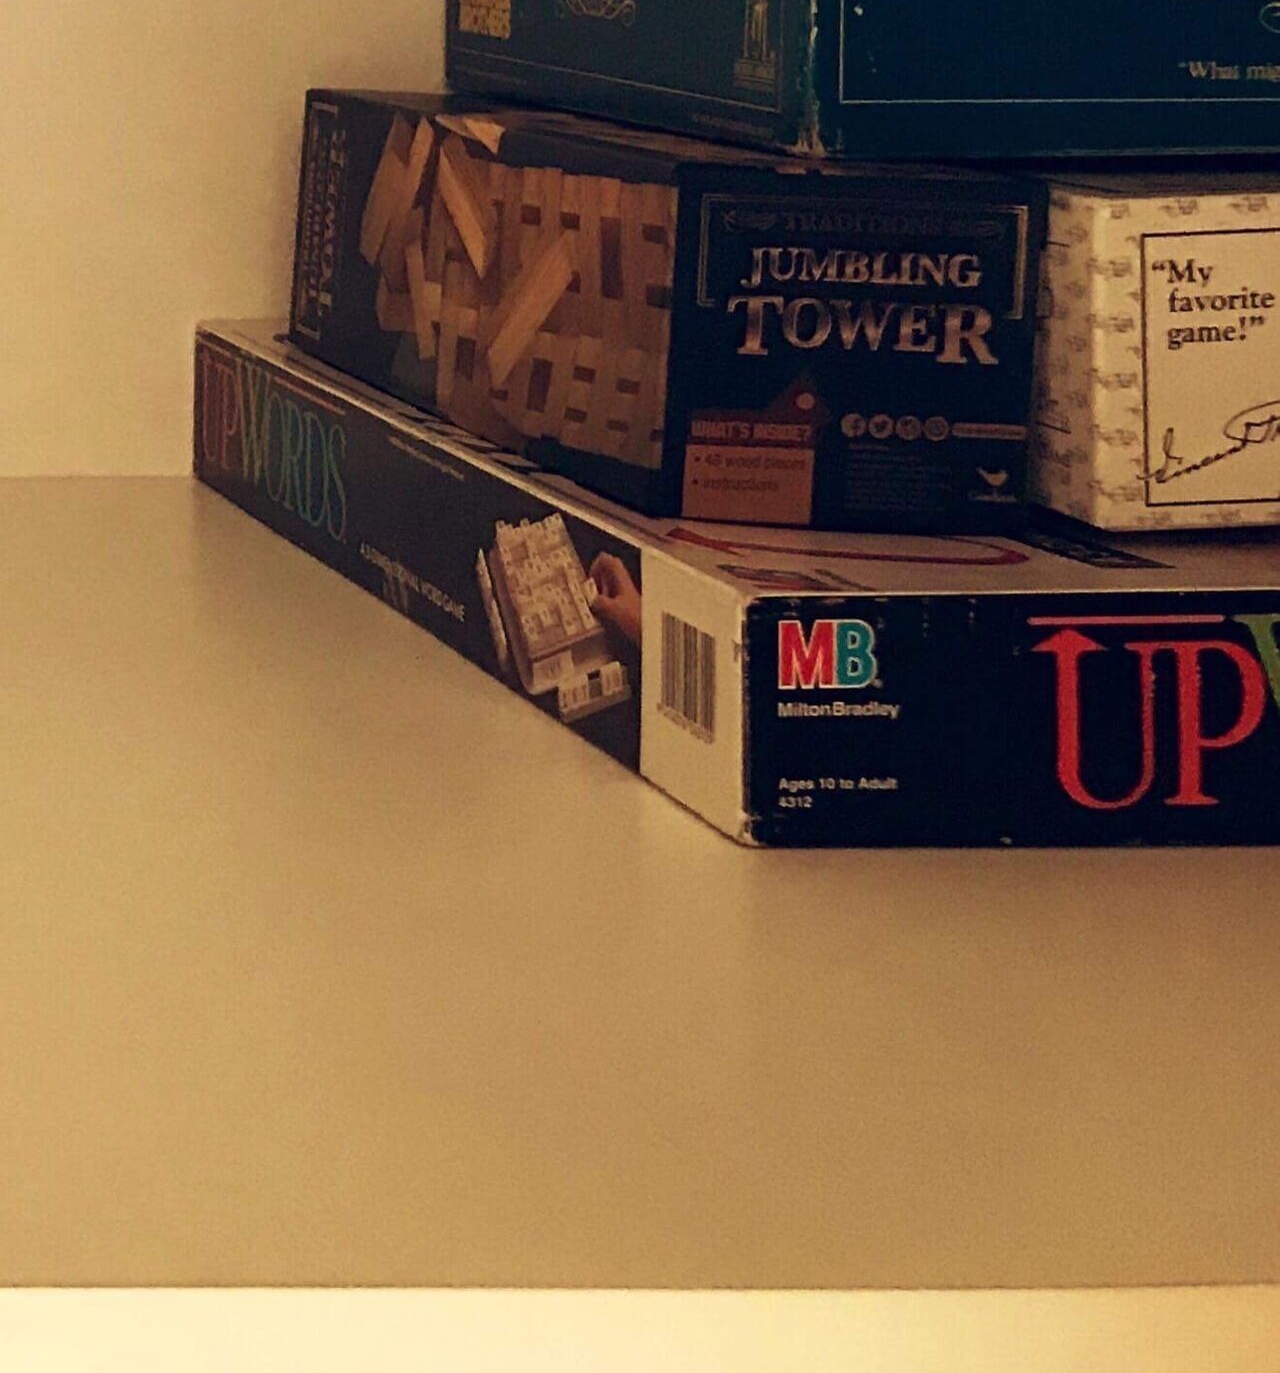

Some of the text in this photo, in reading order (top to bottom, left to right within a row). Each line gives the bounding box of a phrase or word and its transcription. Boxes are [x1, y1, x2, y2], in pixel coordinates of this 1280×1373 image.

[740, 246, 983, 288] JUMBLING
[1152, 258, 1214, 287] “My
[1168, 287, 1276, 313] favorite
[726, 294, 999, 365] TOWER
[1167, 315, 1265, 350] game!”
[777, 618, 878, 690] MB
[778, 778, 898, 792] Ages 10 to Adult
[777, 795, 813, 808] 4312
